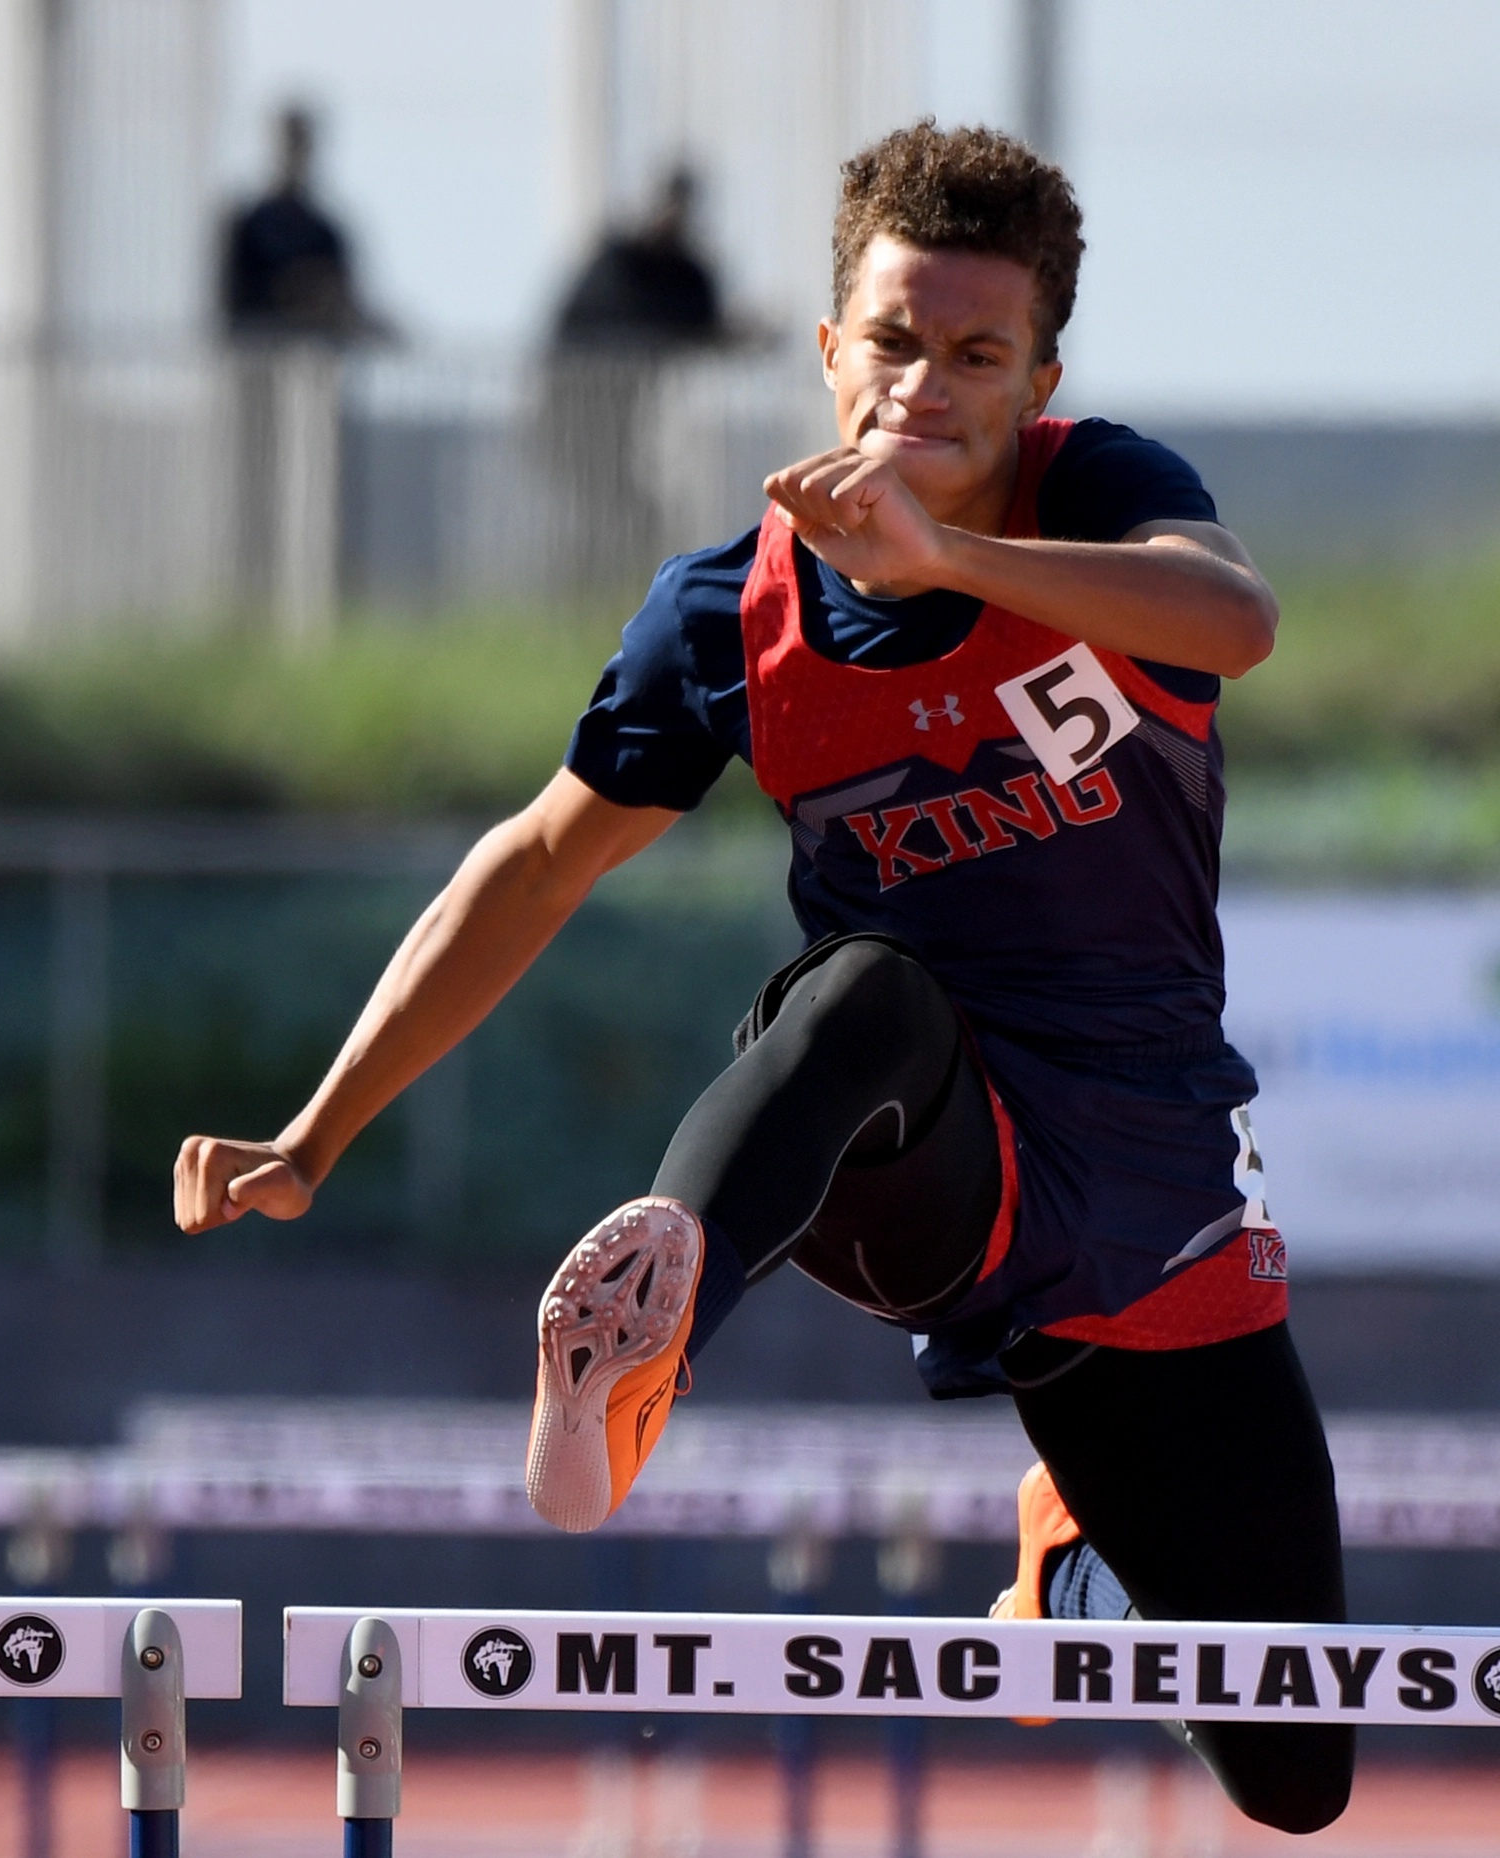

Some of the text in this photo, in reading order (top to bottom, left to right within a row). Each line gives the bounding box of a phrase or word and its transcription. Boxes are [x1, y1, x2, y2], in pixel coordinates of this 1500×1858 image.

[1022, 660, 1111, 767] 5
[842, 757, 1123, 893] KING
[556, 1631, 1458, 1712] MT. SAC RELAYS
